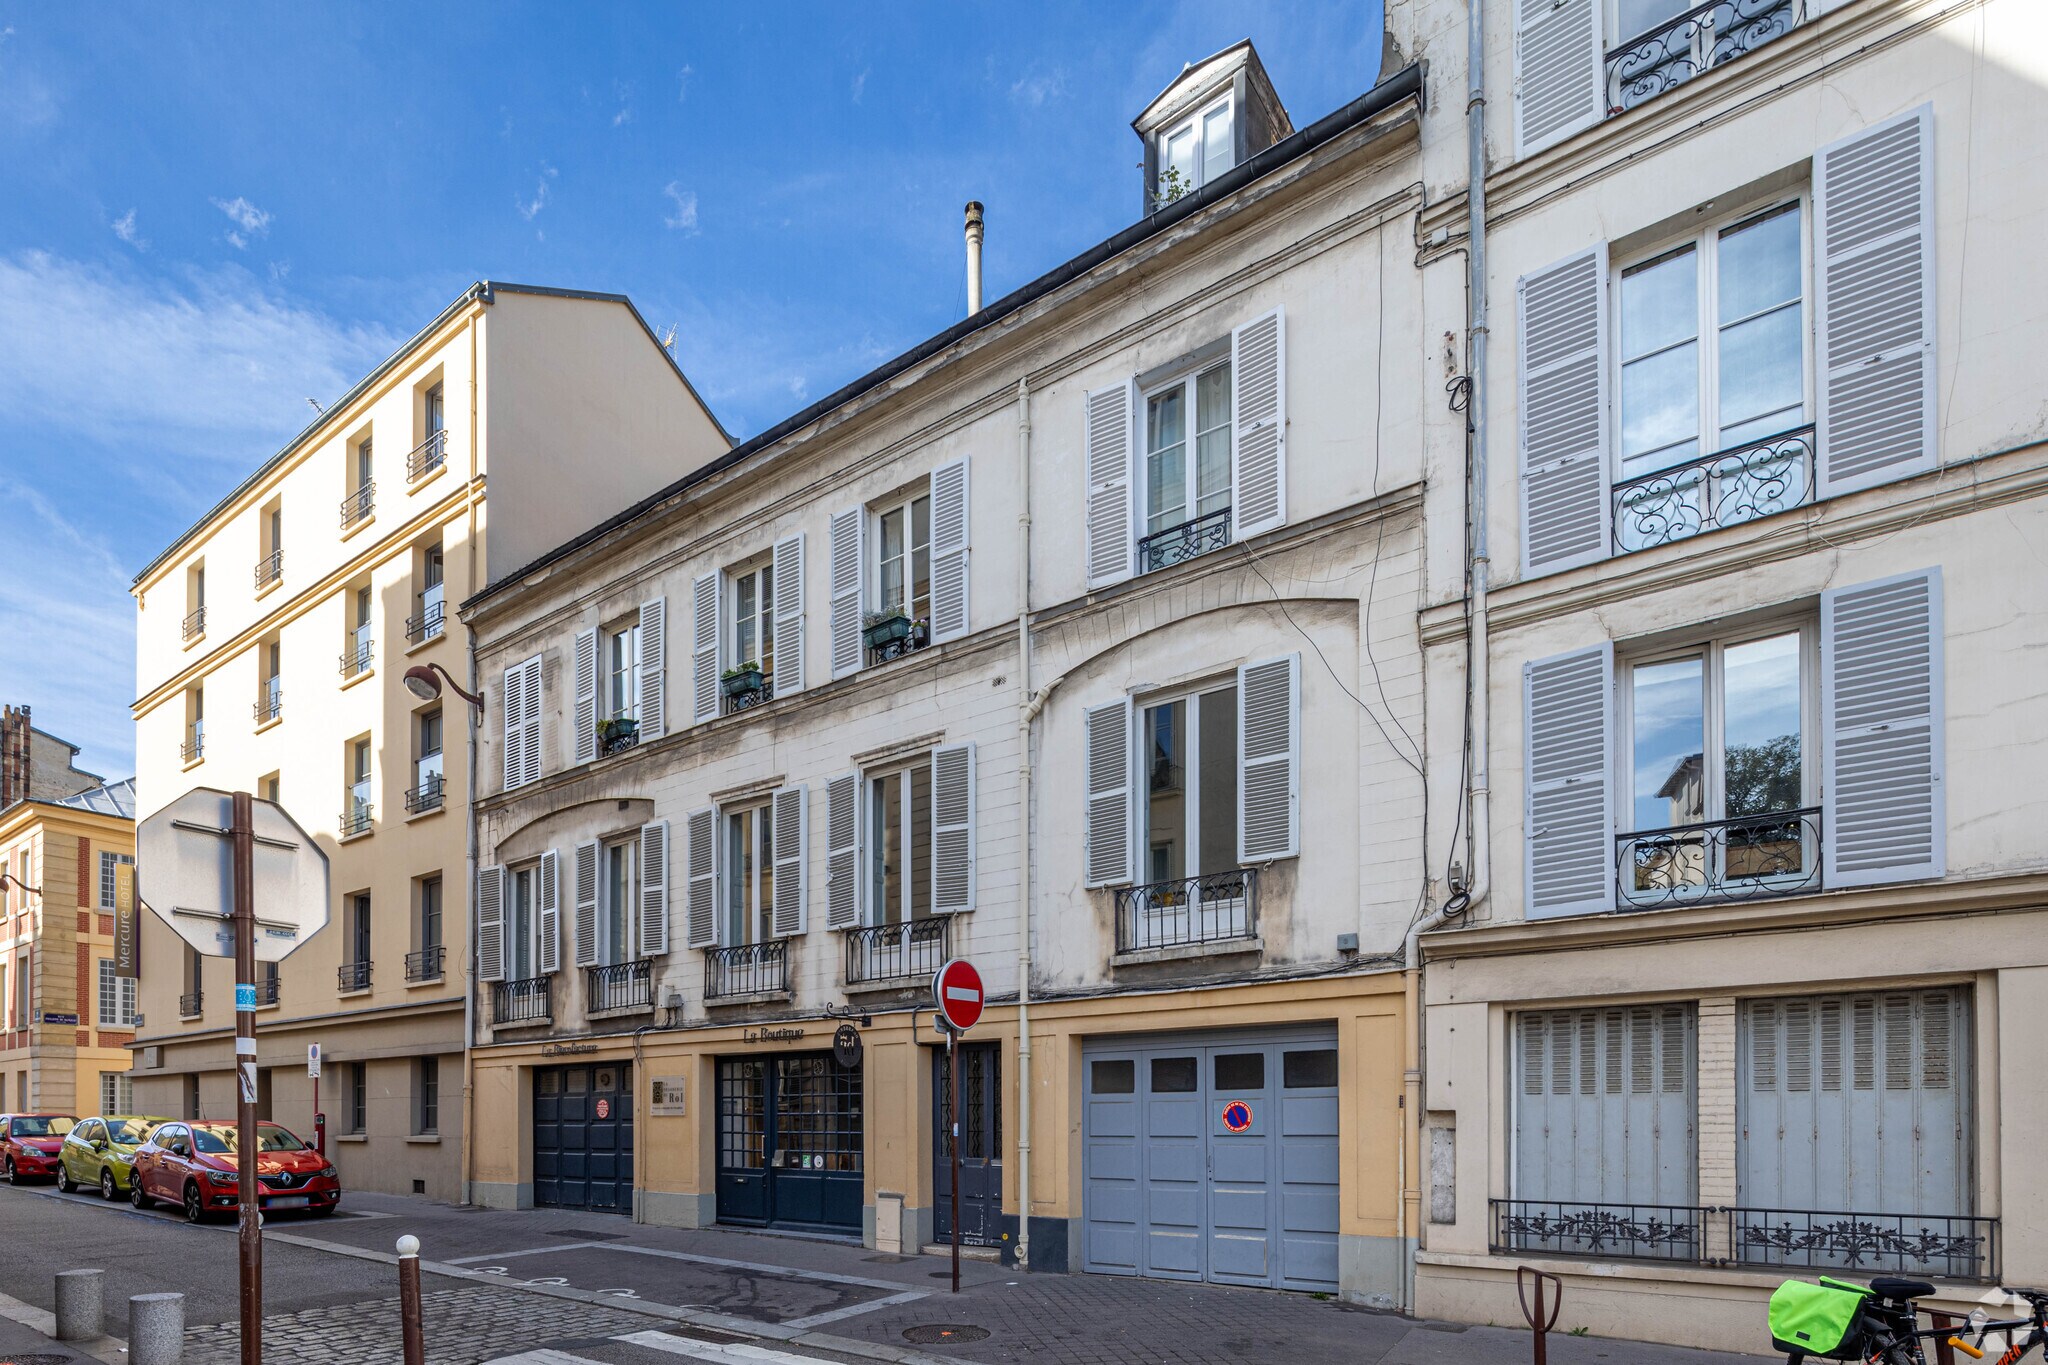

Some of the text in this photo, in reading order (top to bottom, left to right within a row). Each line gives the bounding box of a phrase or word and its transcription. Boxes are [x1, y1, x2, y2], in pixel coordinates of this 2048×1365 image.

[119, 874, 130, 968] Mercure HOTEL
[744, 1027, 804, 1045] La Boutique
